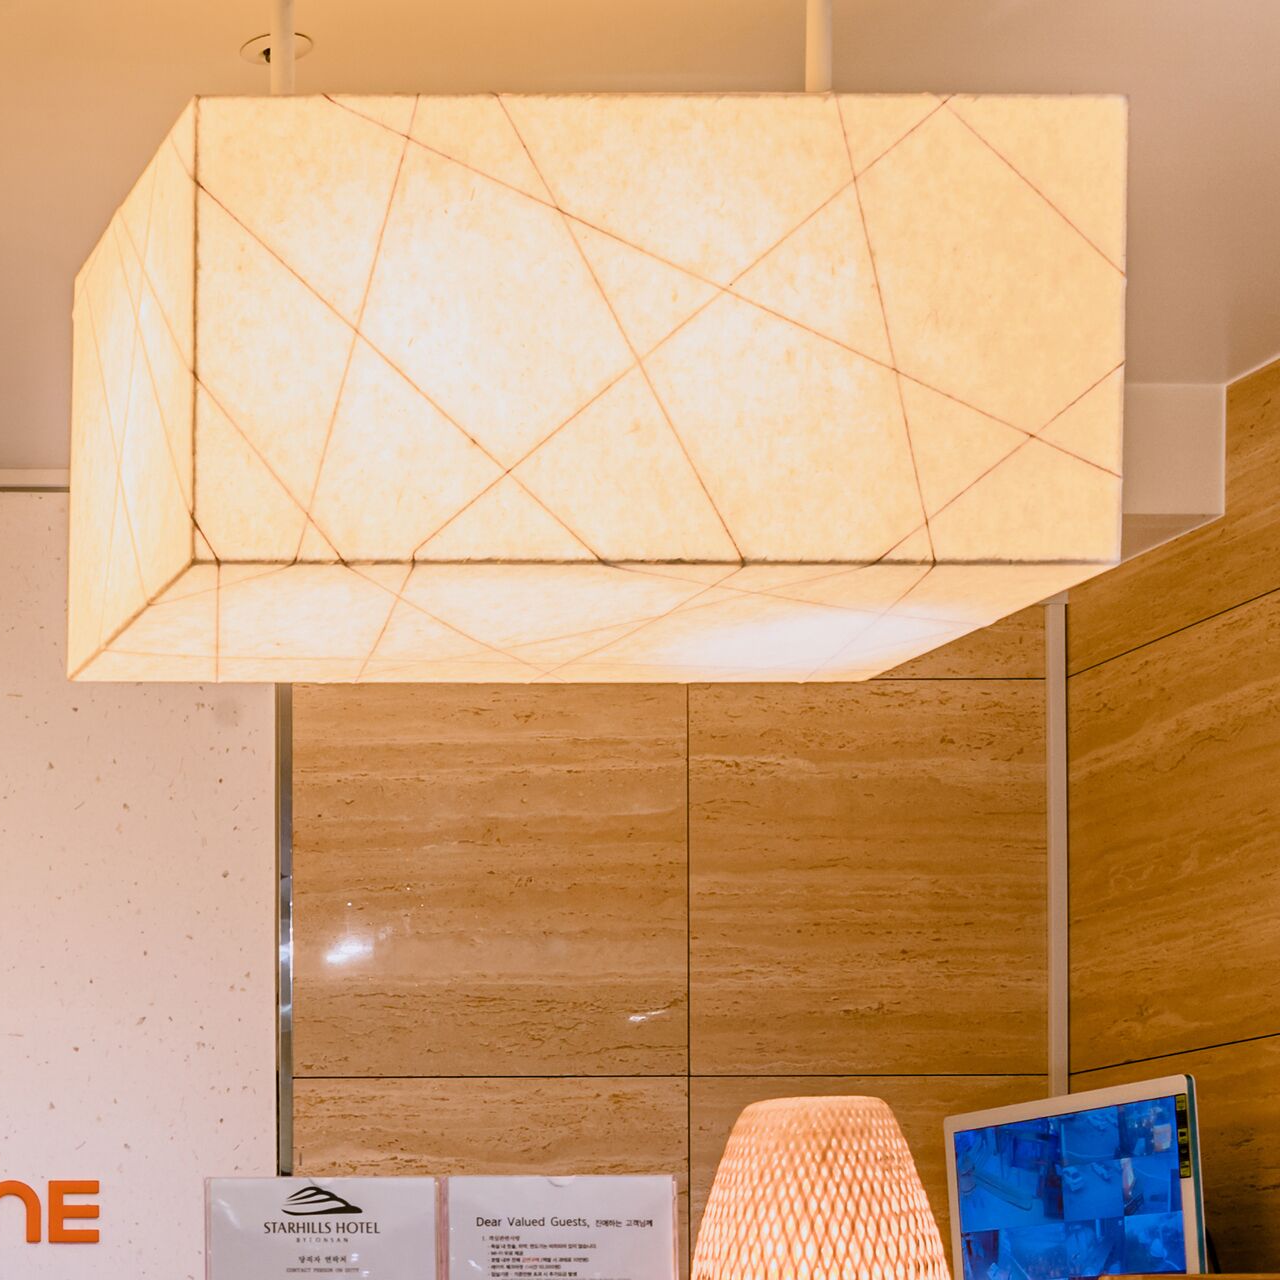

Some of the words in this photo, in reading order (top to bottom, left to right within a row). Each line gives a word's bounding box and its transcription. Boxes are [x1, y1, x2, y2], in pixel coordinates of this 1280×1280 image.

[264, 1222, 332, 1234] STARHILLS
[336, 1222, 381, 1234] HOTEL
[476, 1216, 501, 1227] Dear
[507, 1216, 545, 1227] Valued
[550, 1216, 590, 1228] Guests,
